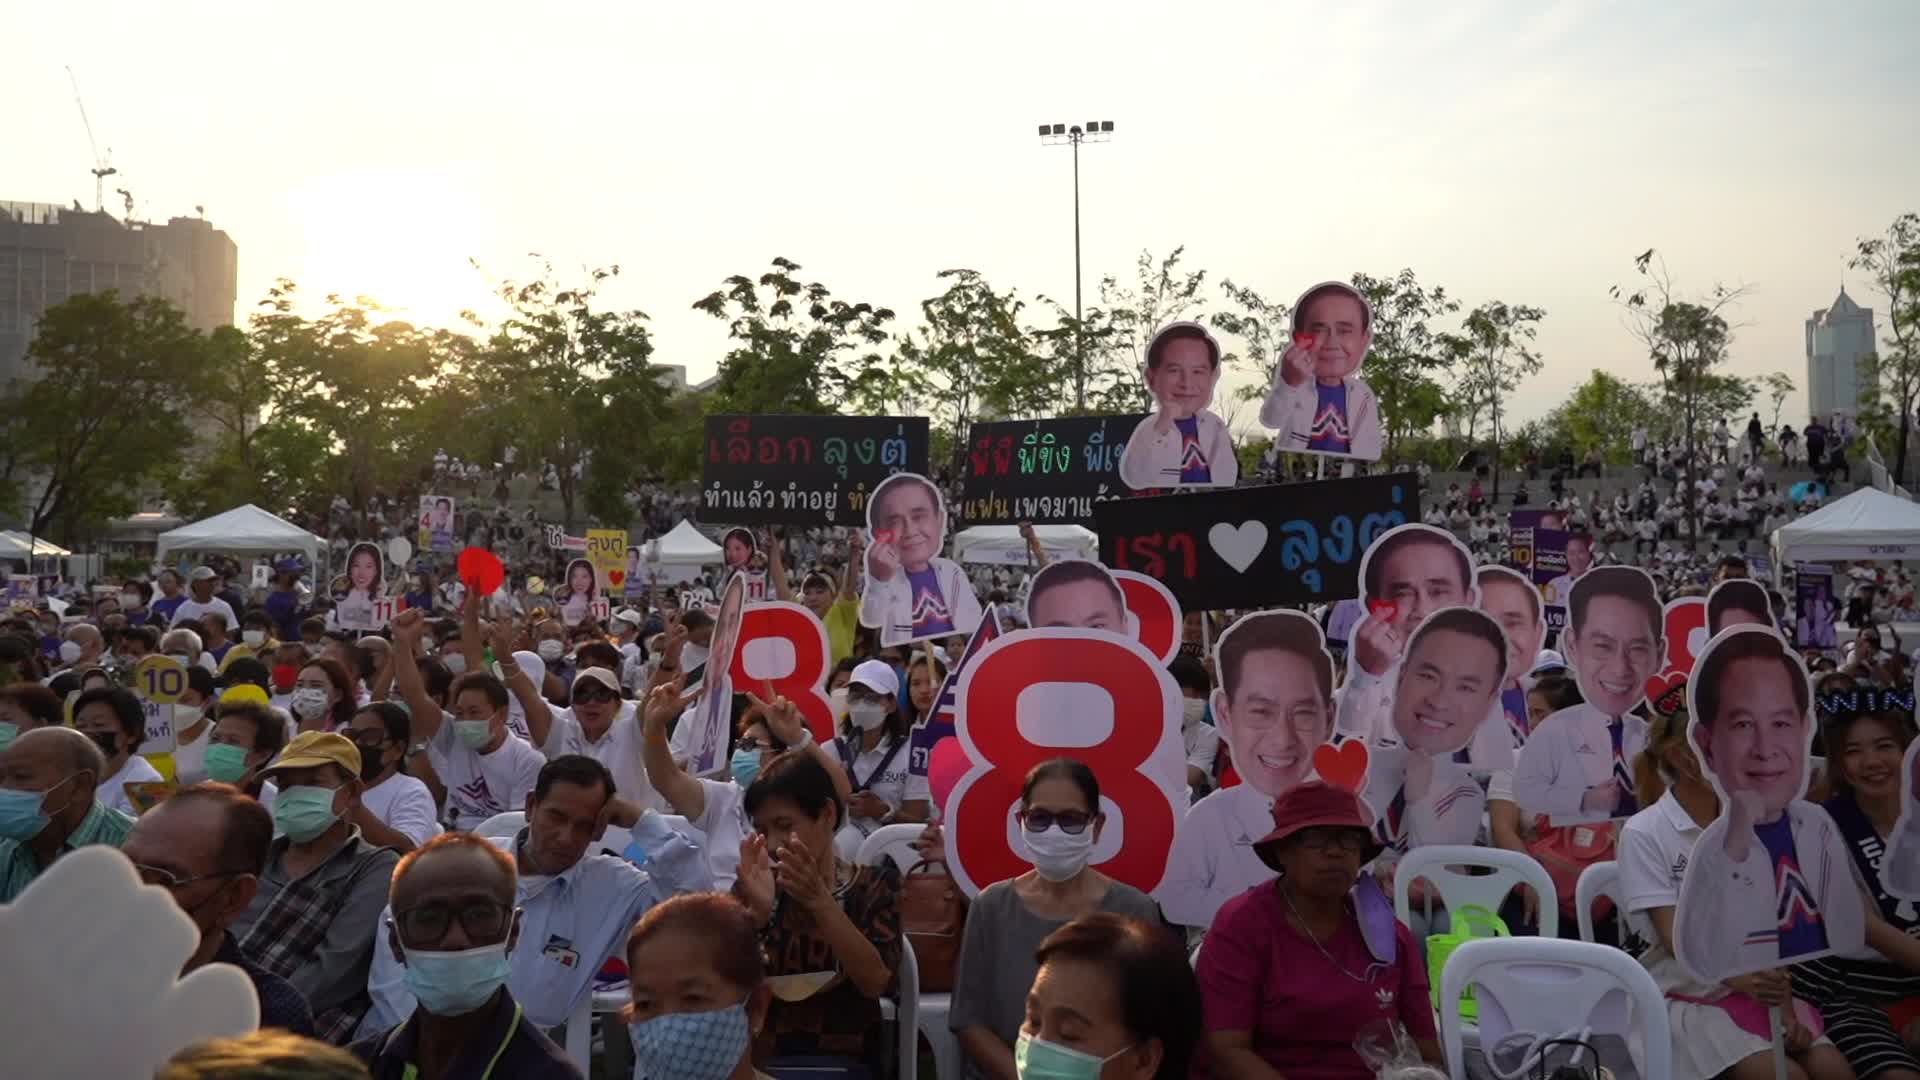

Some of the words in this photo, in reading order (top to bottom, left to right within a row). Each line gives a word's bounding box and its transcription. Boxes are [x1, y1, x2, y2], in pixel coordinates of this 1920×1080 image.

[704, 479, 776, 509] ทำแล้ว
[780, 482, 839, 521] ทำอยู่
[964, 490, 1010, 520] แฟน
[1112, 528, 1199, 580] เรา
[1279, 484, 1408, 593] ลุงต่
[747, 582, 763, 598] 11
[373, 602, 392, 621] 11
[592, 602, 607, 617] 11
[144, 668, 182, 696] 10
[911, 746, 933, 769] รว
[956, 638, 1175, 896] 8
